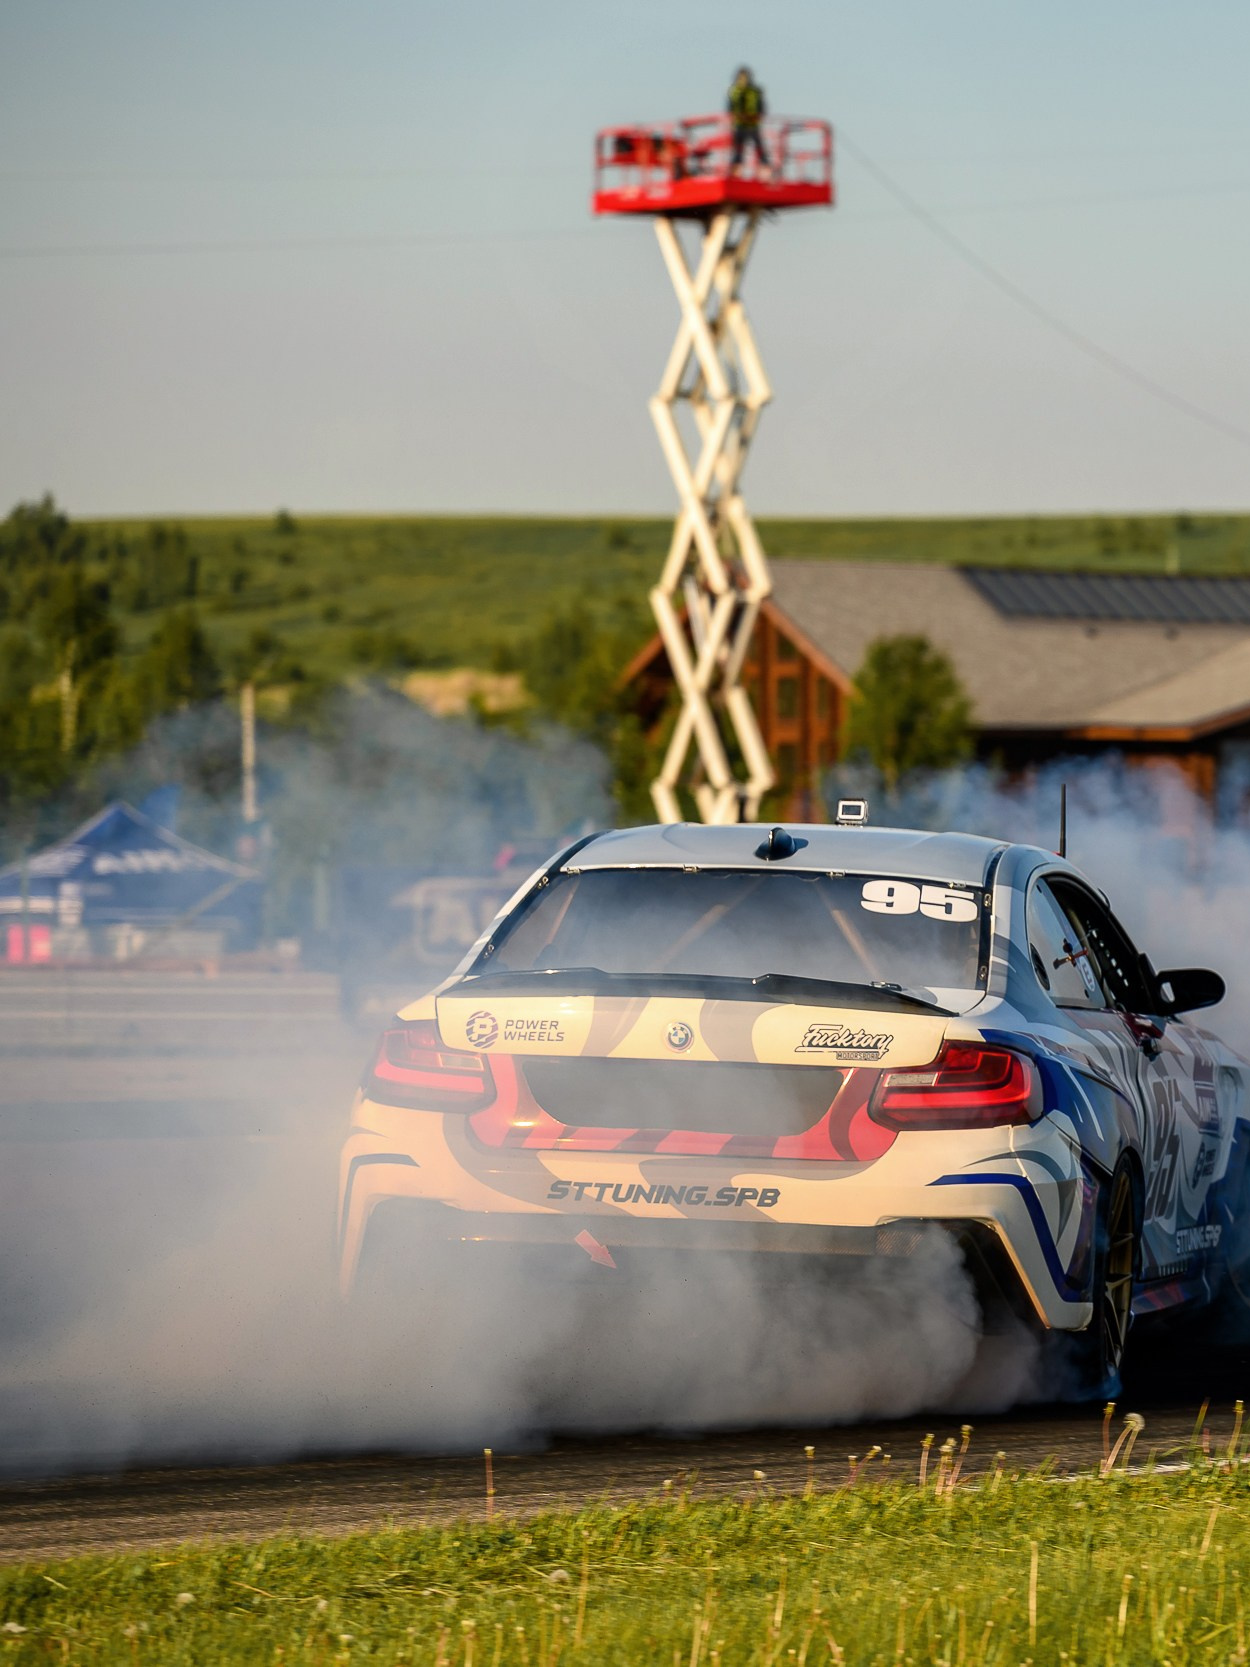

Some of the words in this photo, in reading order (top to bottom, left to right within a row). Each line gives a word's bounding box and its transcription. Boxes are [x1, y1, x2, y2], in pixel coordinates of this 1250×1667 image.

[860, 880, 978, 922] 95
[505, 1019, 559, 1030] POWER
[503, 1031, 565, 1042] WHEELS
[800, 1023, 894, 1059] Fucktory
[837, 1051, 879, 1060] MOTORSPORT
[546, 1180, 781, 1208] STTUNING.SPB
